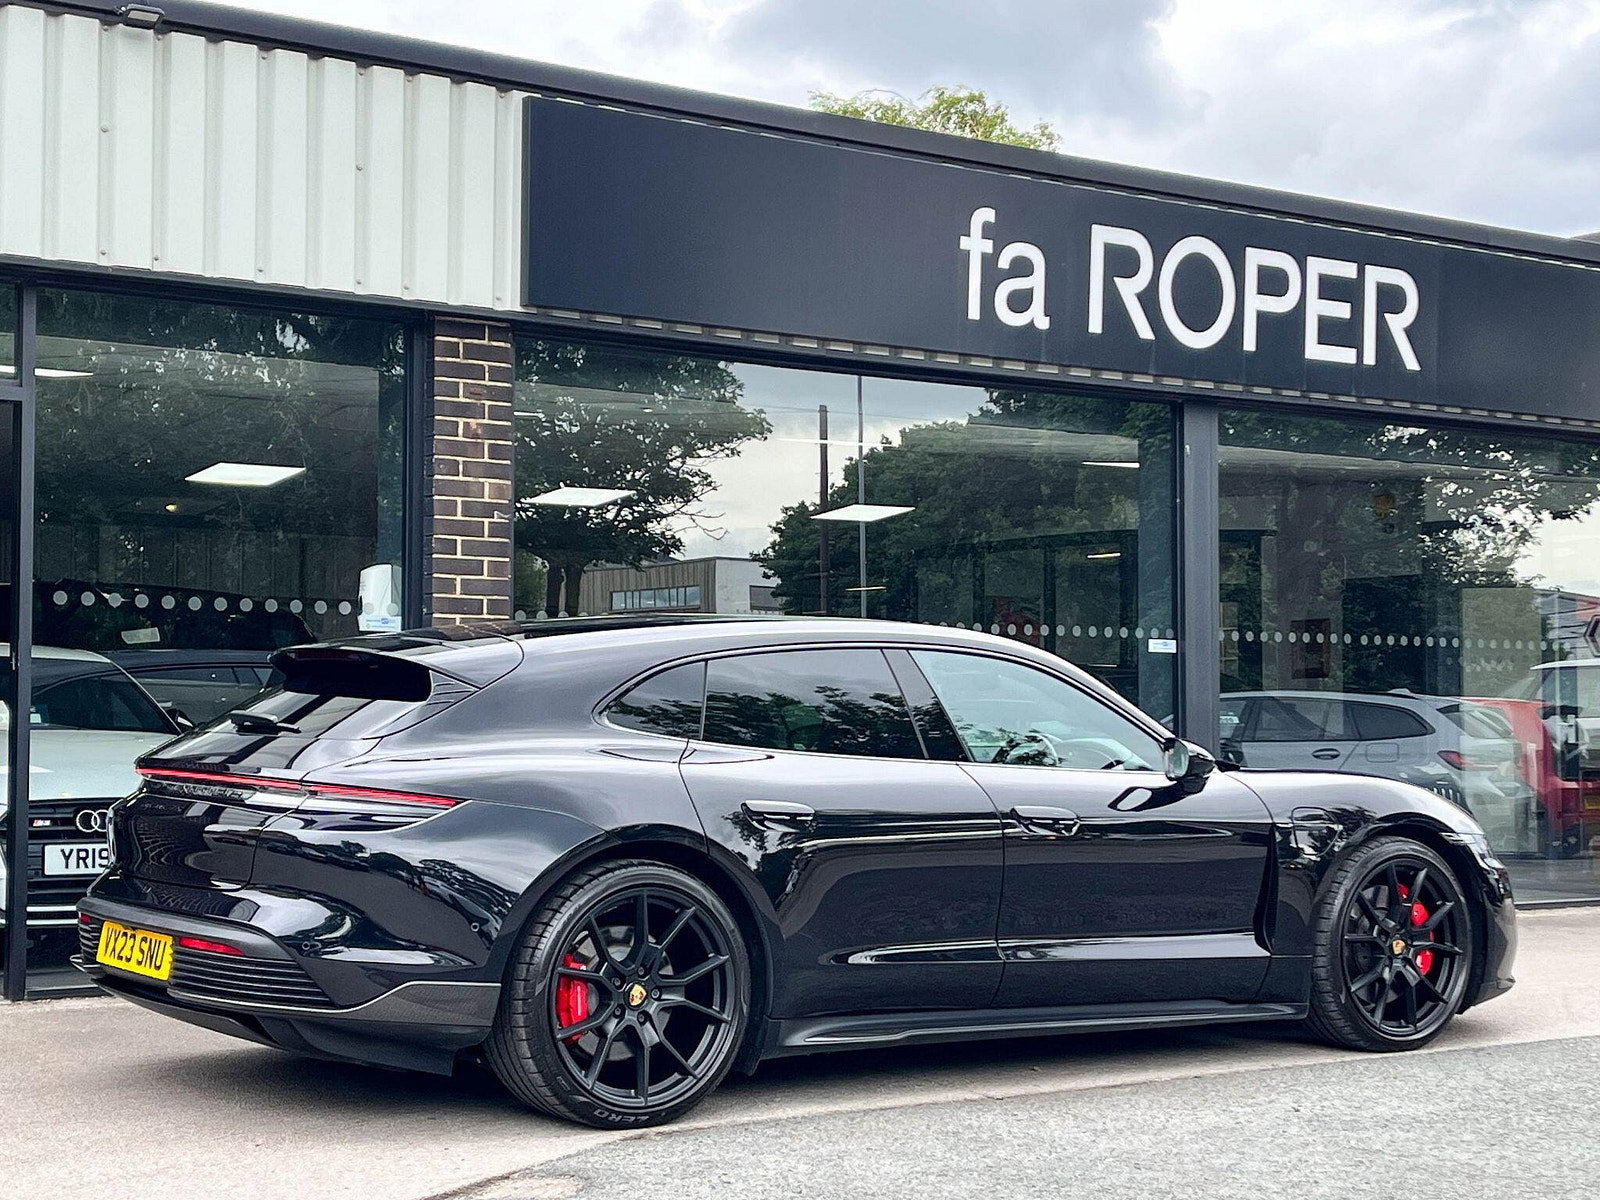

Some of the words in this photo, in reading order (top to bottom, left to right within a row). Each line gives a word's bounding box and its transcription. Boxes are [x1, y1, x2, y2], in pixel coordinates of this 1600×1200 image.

[959, 207, 1050, 330] fa
[1088, 224, 1421, 371] ROPER
[103, 927, 137, 963] VX23
[136, 936, 167, 971] SNU
